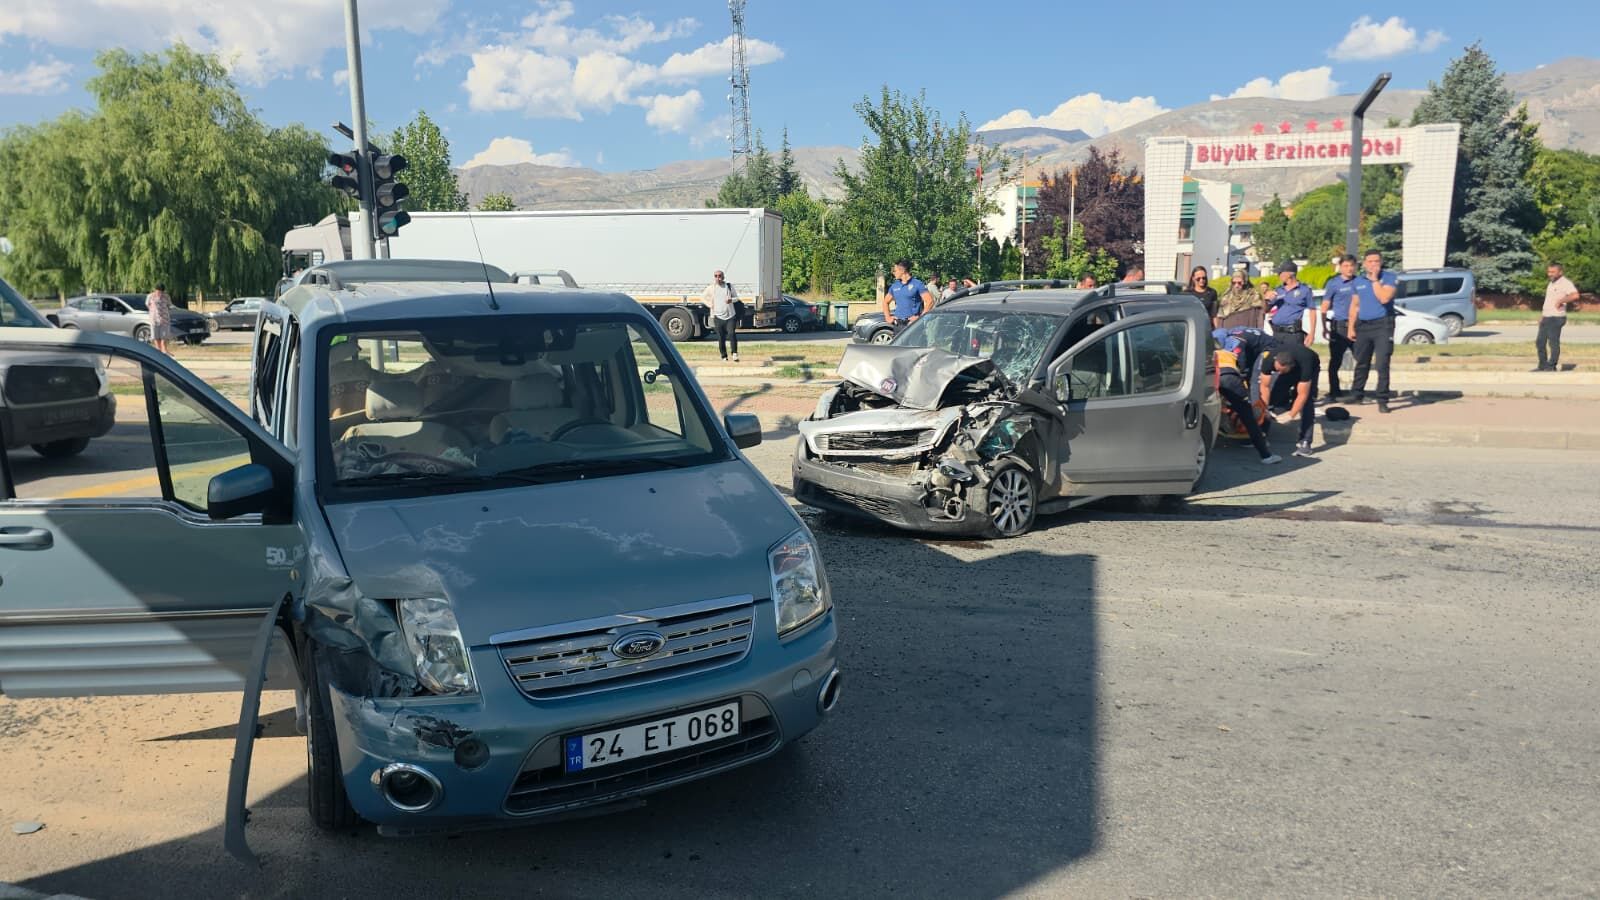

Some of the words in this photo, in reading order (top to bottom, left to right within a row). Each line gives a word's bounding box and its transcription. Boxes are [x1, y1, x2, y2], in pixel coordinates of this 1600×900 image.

[1197, 143, 1258, 166] Büyük
[1264, 140, 1352, 161] Erzincan
[1361, 136, 1401, 157] Otel
[629, 640, 653, 654] Ford
[569, 755, 582, 766] TR
[590, 733, 624, 763] 24
[645, 721, 676, 751] ET
[688, 709, 734, 741] 068
